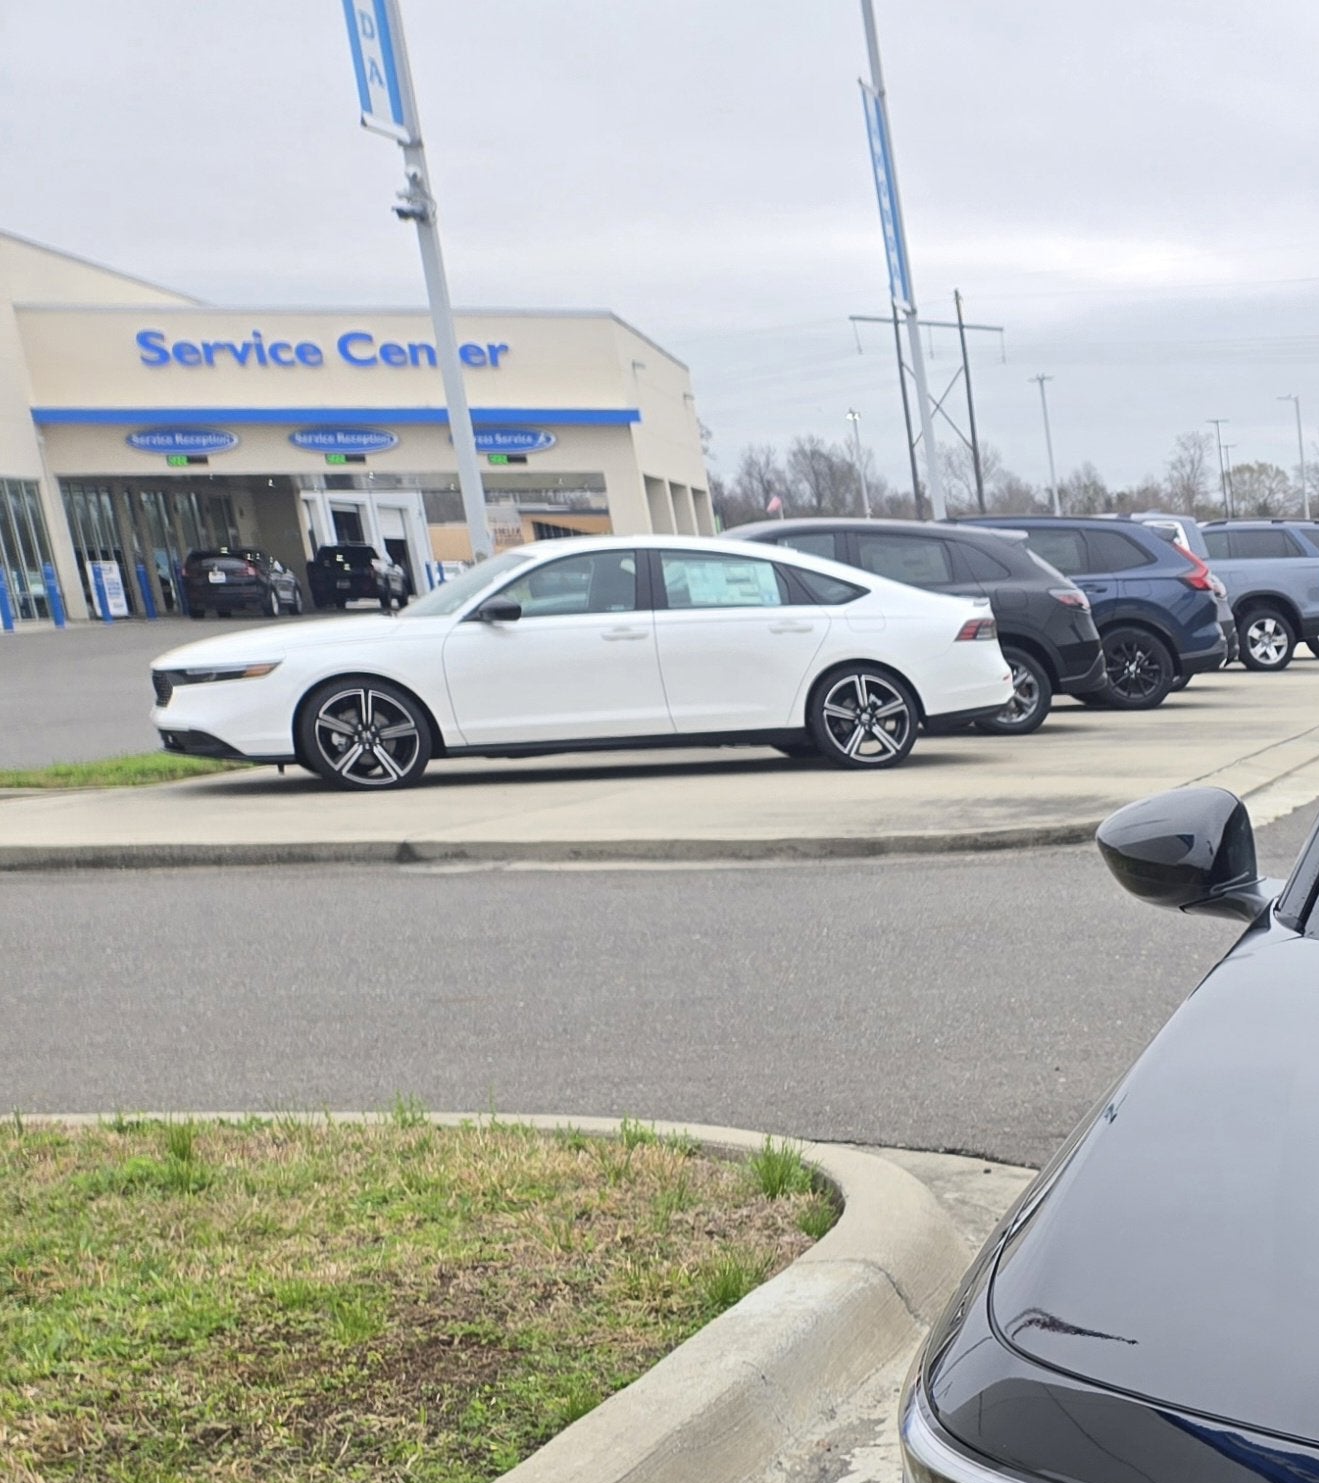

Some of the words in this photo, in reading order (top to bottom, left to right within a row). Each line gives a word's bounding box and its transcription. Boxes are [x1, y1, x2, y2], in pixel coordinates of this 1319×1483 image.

[135, 329, 324, 368] Service
[337, 331, 509, 368] Cener
[131, 433, 173, 446] Service
[175, 432, 230, 446] Reception
[295, 432, 334, 444] Service
[336, 431, 391, 445] Reception
